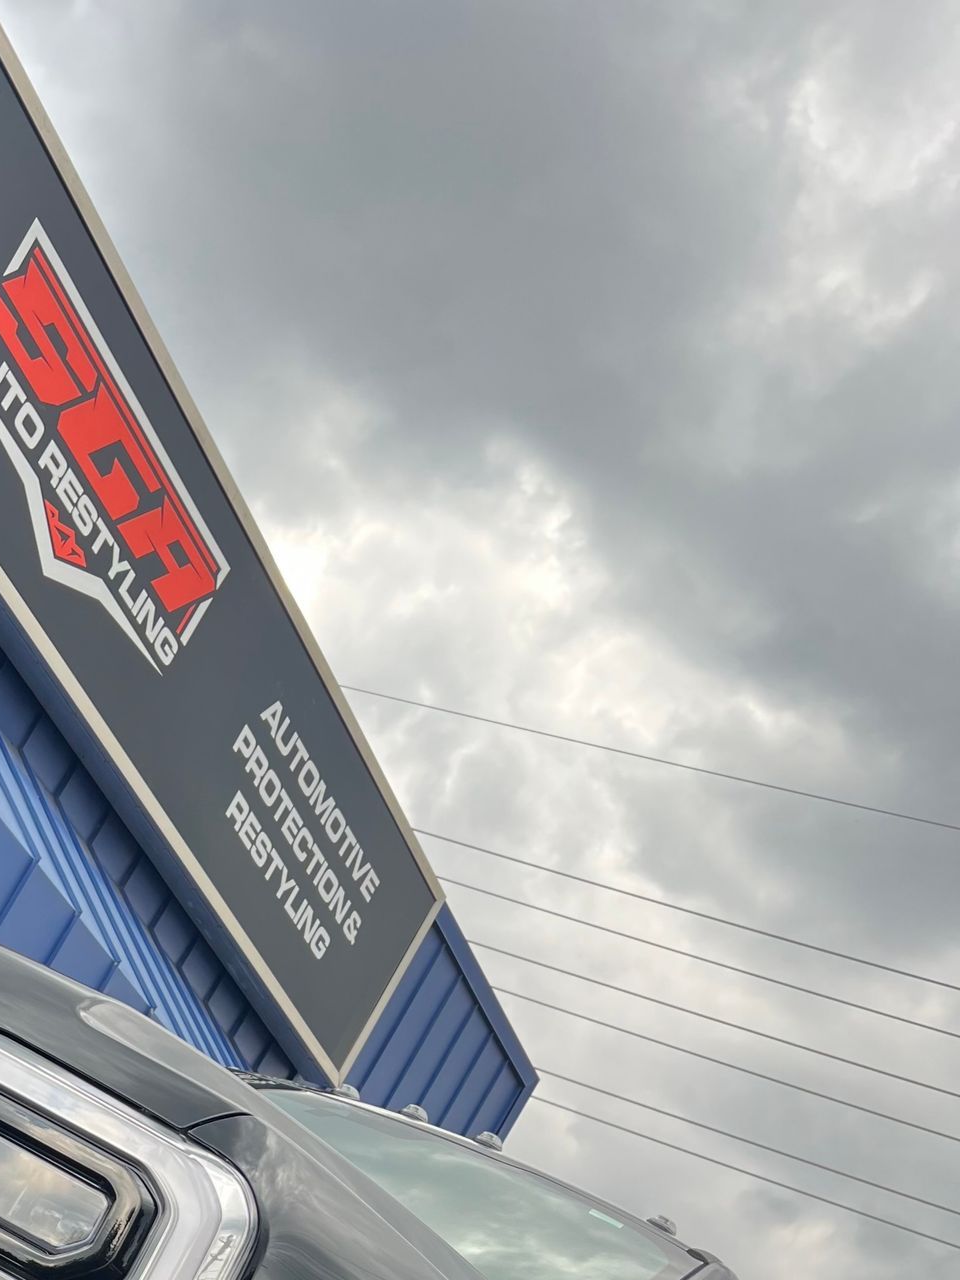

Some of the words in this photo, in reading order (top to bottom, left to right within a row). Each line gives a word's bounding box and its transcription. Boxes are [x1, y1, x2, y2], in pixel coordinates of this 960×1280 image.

[38, 438, 179, 666] RESTYLING
[225, 790, 331, 960] RESTYLING
[233, 724, 354, 925] PROTECTION
[260, 701, 380, 902] AUTOMOTIVE
